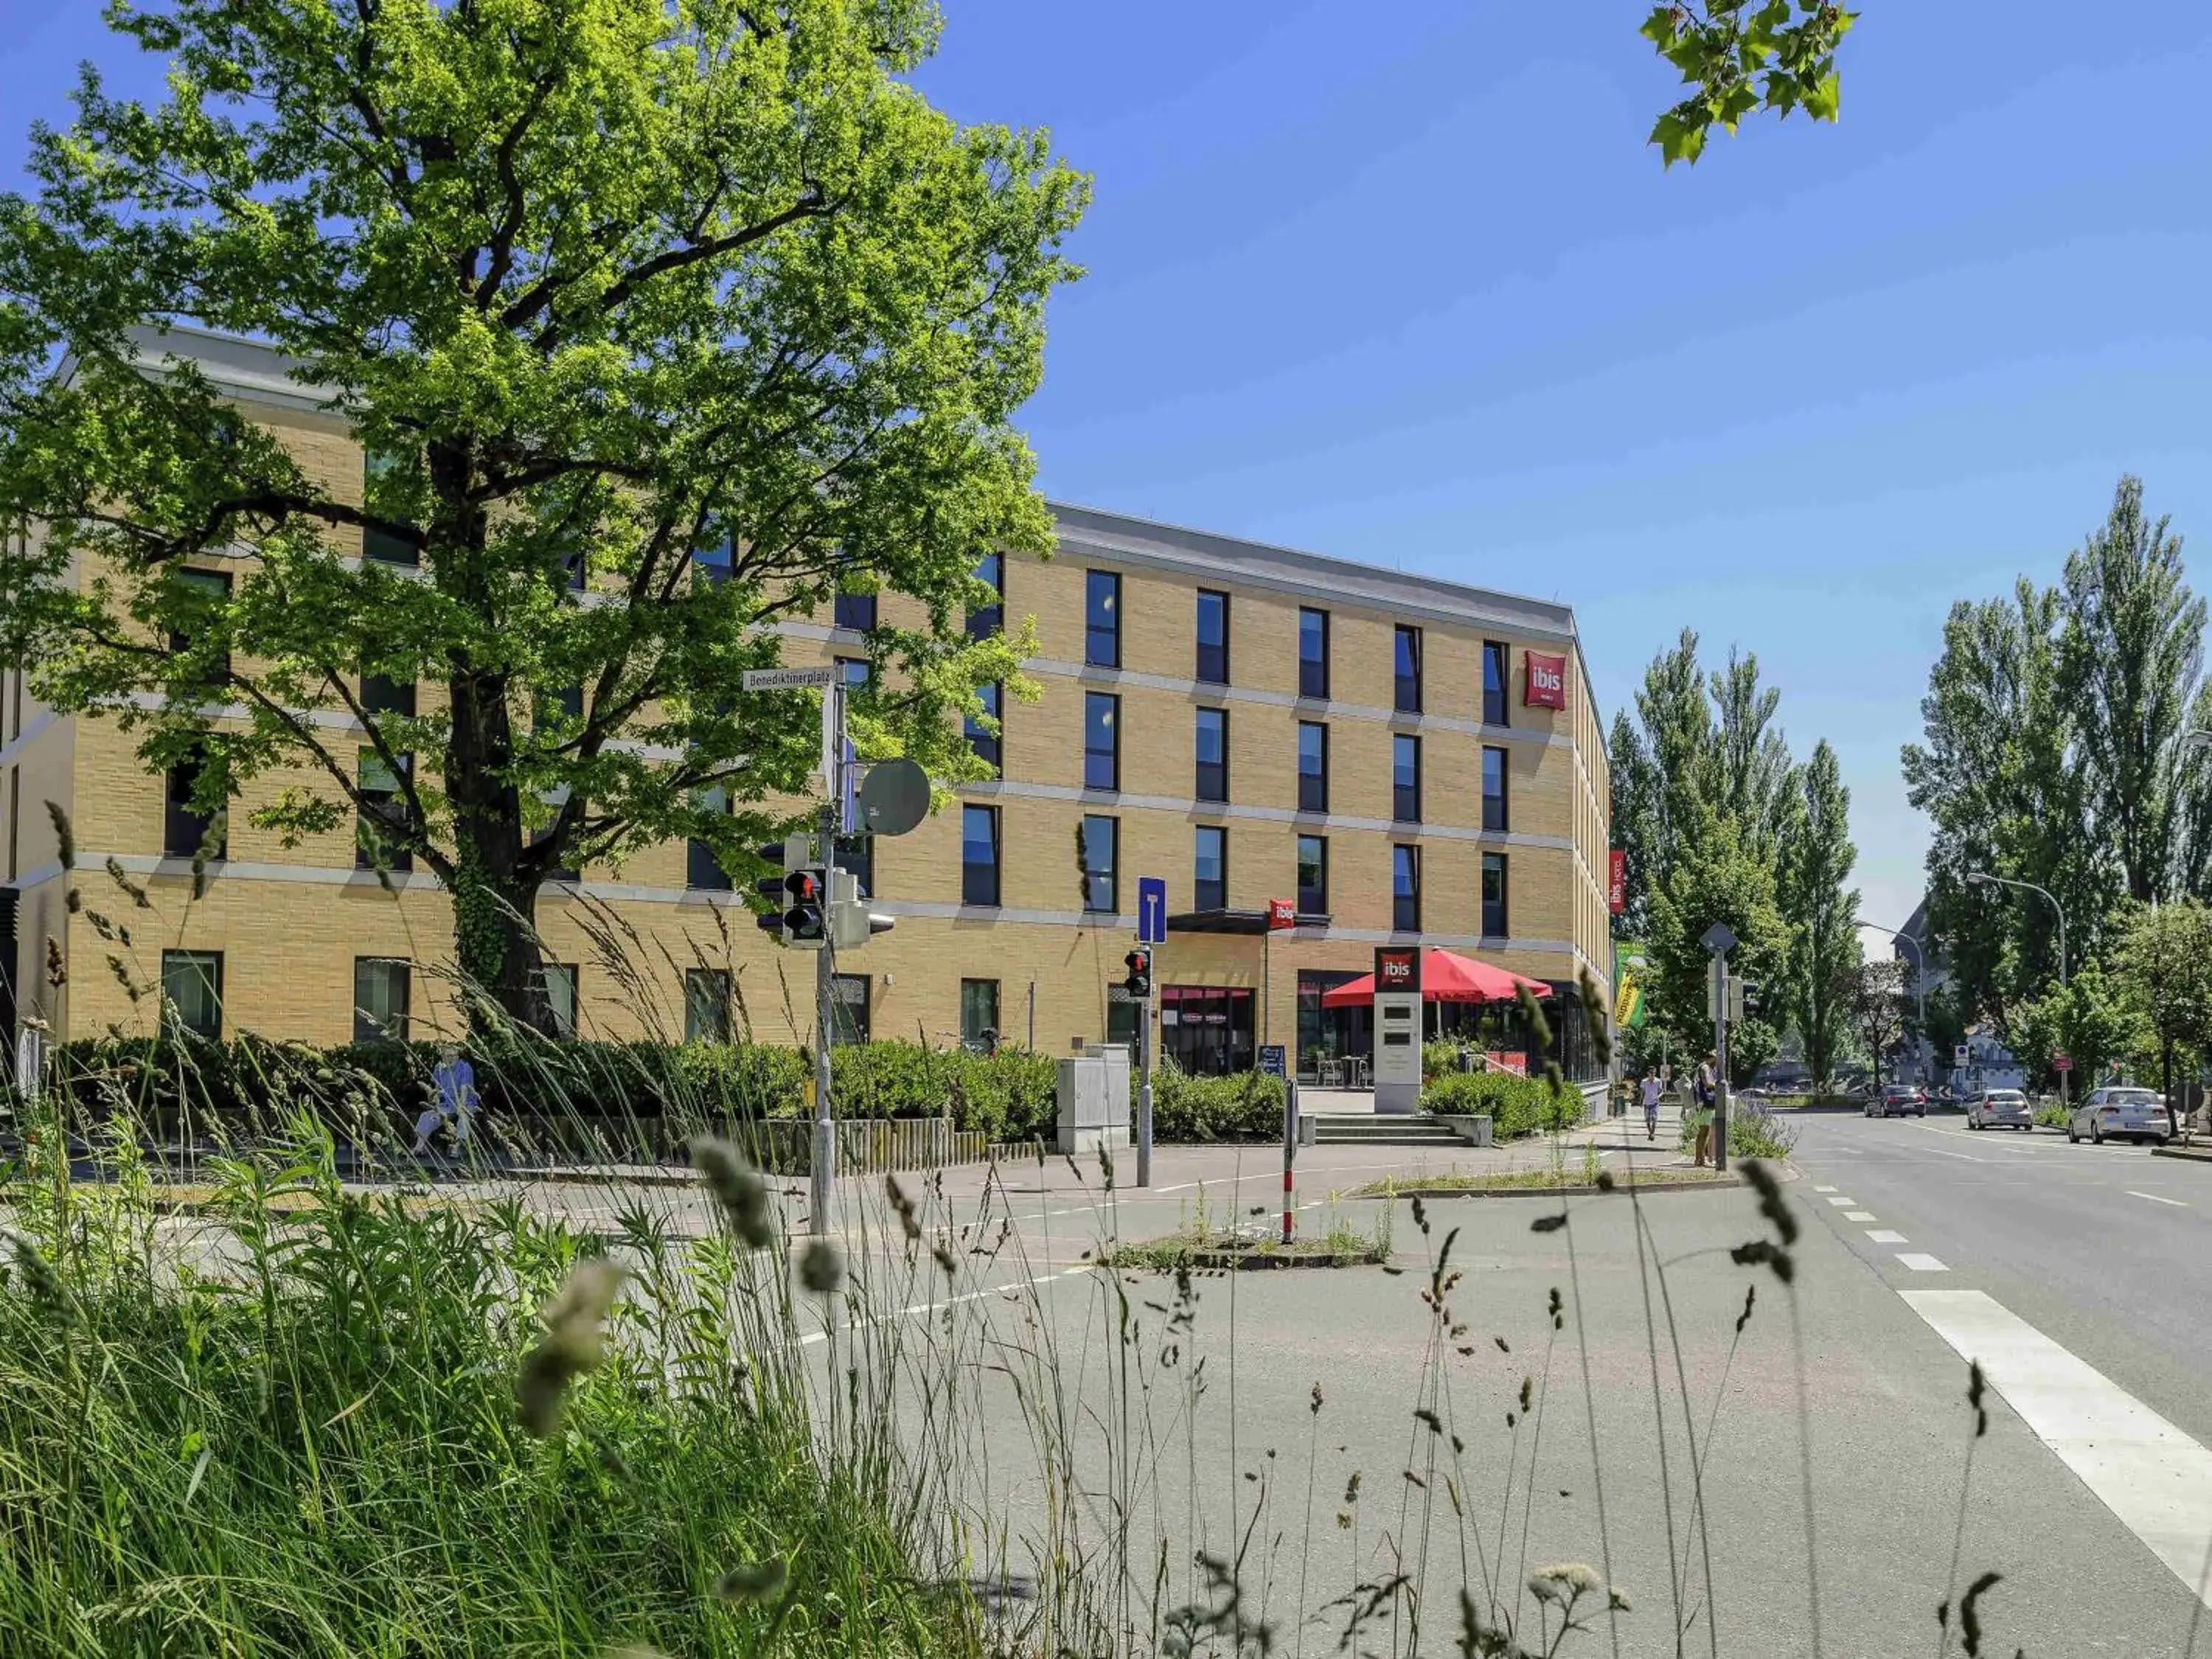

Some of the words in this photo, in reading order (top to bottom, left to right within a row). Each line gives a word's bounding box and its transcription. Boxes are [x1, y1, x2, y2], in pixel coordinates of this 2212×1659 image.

[749, 670, 830, 686] Benediktinerplatz
[1533, 666, 1560, 691] ibis
[1610, 884, 1621, 903] ibis
[1276, 905, 1294, 919] ibis
[1385, 961, 1410, 975] ibis
